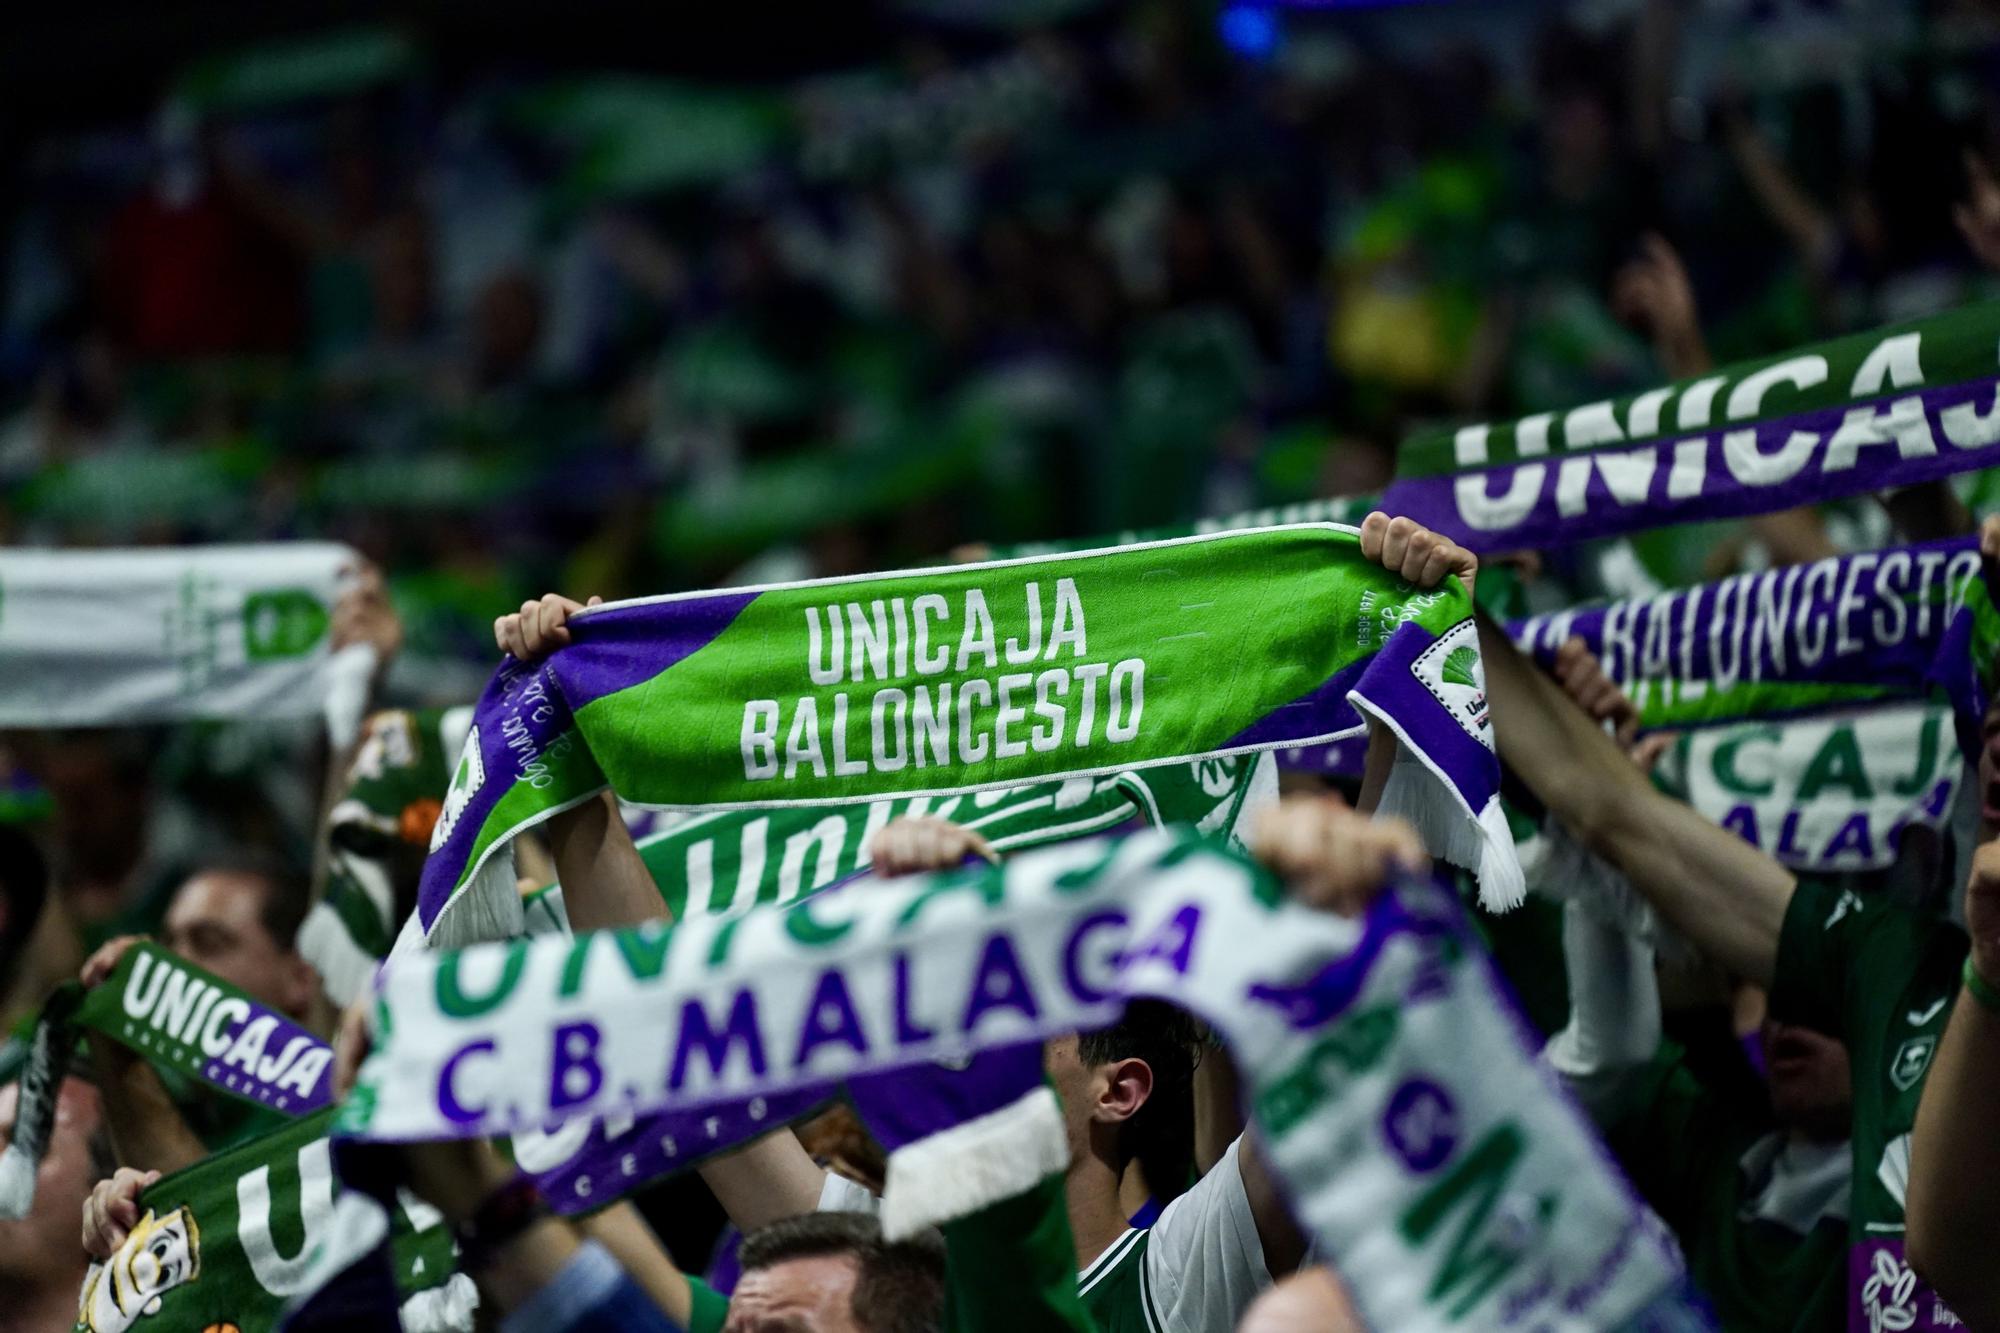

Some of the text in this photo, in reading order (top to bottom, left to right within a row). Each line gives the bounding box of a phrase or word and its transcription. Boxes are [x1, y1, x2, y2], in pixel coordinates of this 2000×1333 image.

[805, 577, 1088, 686] UNICAJA
[740, 658, 1146, 781] BALONCESTO
[122, 951, 334, 1098] UNICAJA
[667, 903, 1203, 1092] MALAGA
